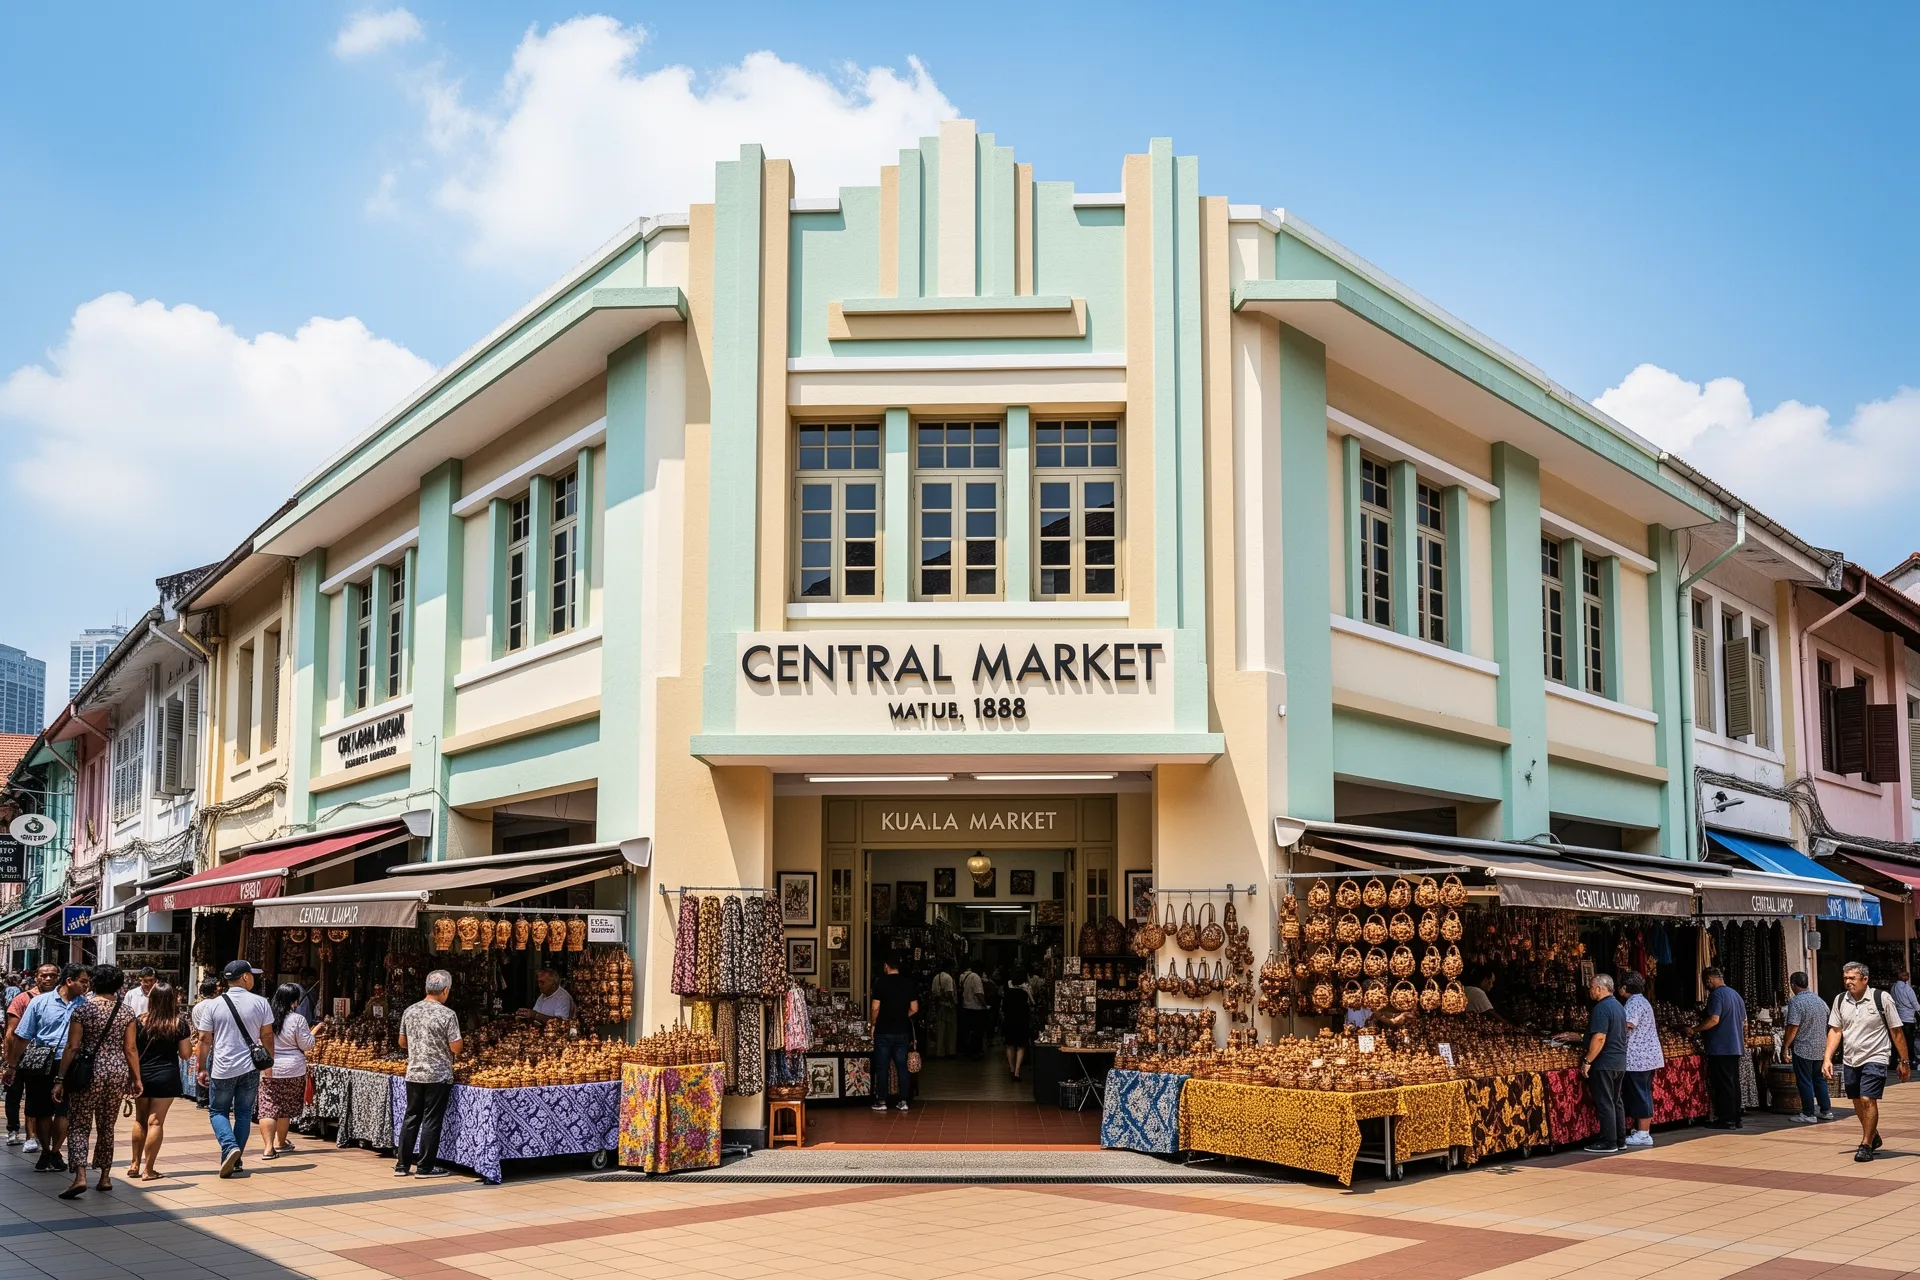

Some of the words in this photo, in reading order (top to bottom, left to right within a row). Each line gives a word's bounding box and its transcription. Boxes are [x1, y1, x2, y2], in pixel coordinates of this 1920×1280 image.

[742, 644, 953, 683] CENTRAL
[972, 642, 1163, 682] MARKET
[973, 697, 1027, 719] 1888
[969, 811, 1058, 831] MARKET
